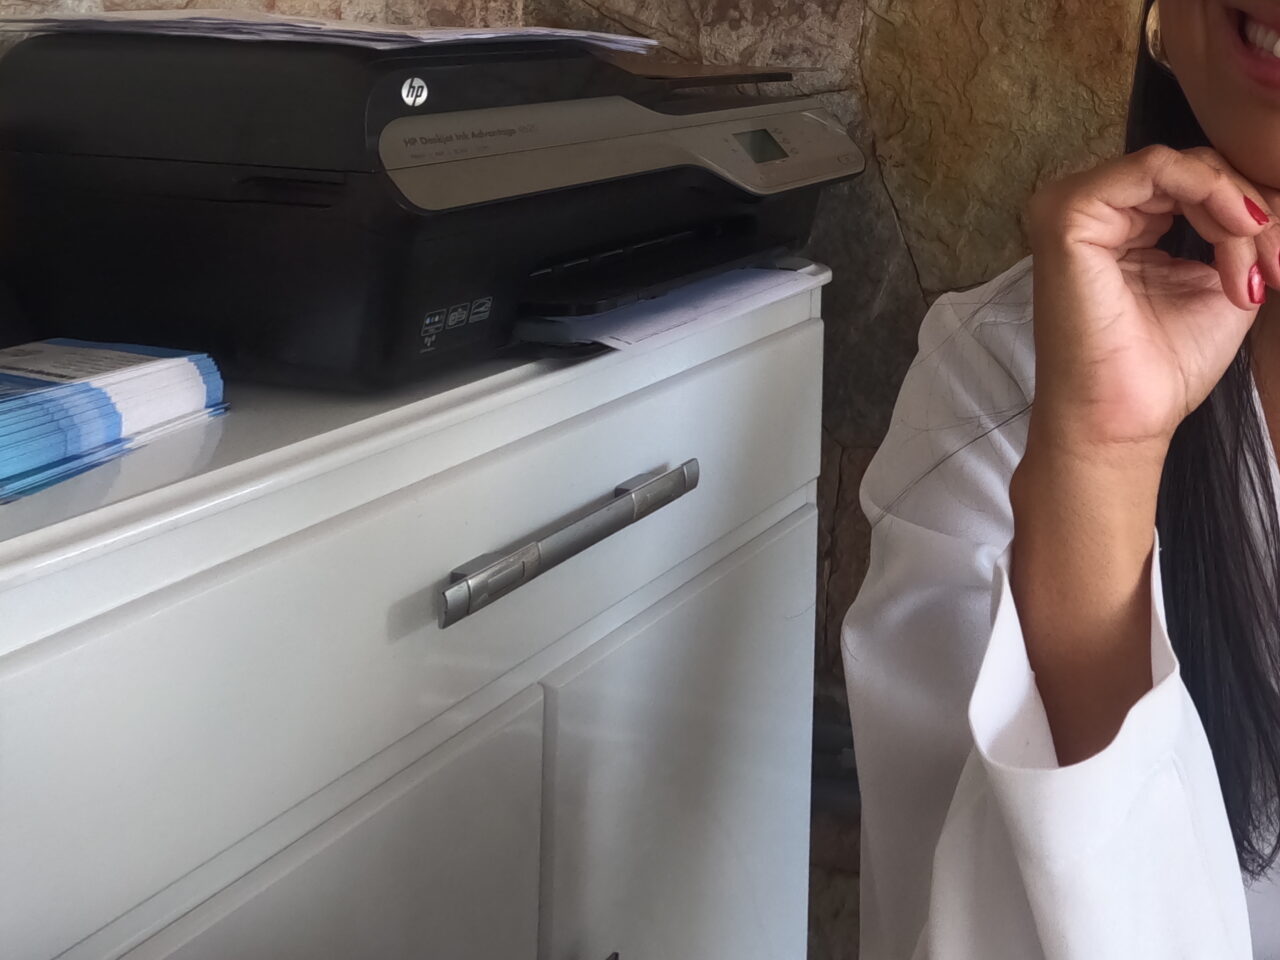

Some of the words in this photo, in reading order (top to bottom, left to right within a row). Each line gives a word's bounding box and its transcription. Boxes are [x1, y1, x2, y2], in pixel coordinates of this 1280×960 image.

[405, 77, 425, 107] hp
[403, 138, 419, 147] HP
[471, 127, 518, 138] Advantage
